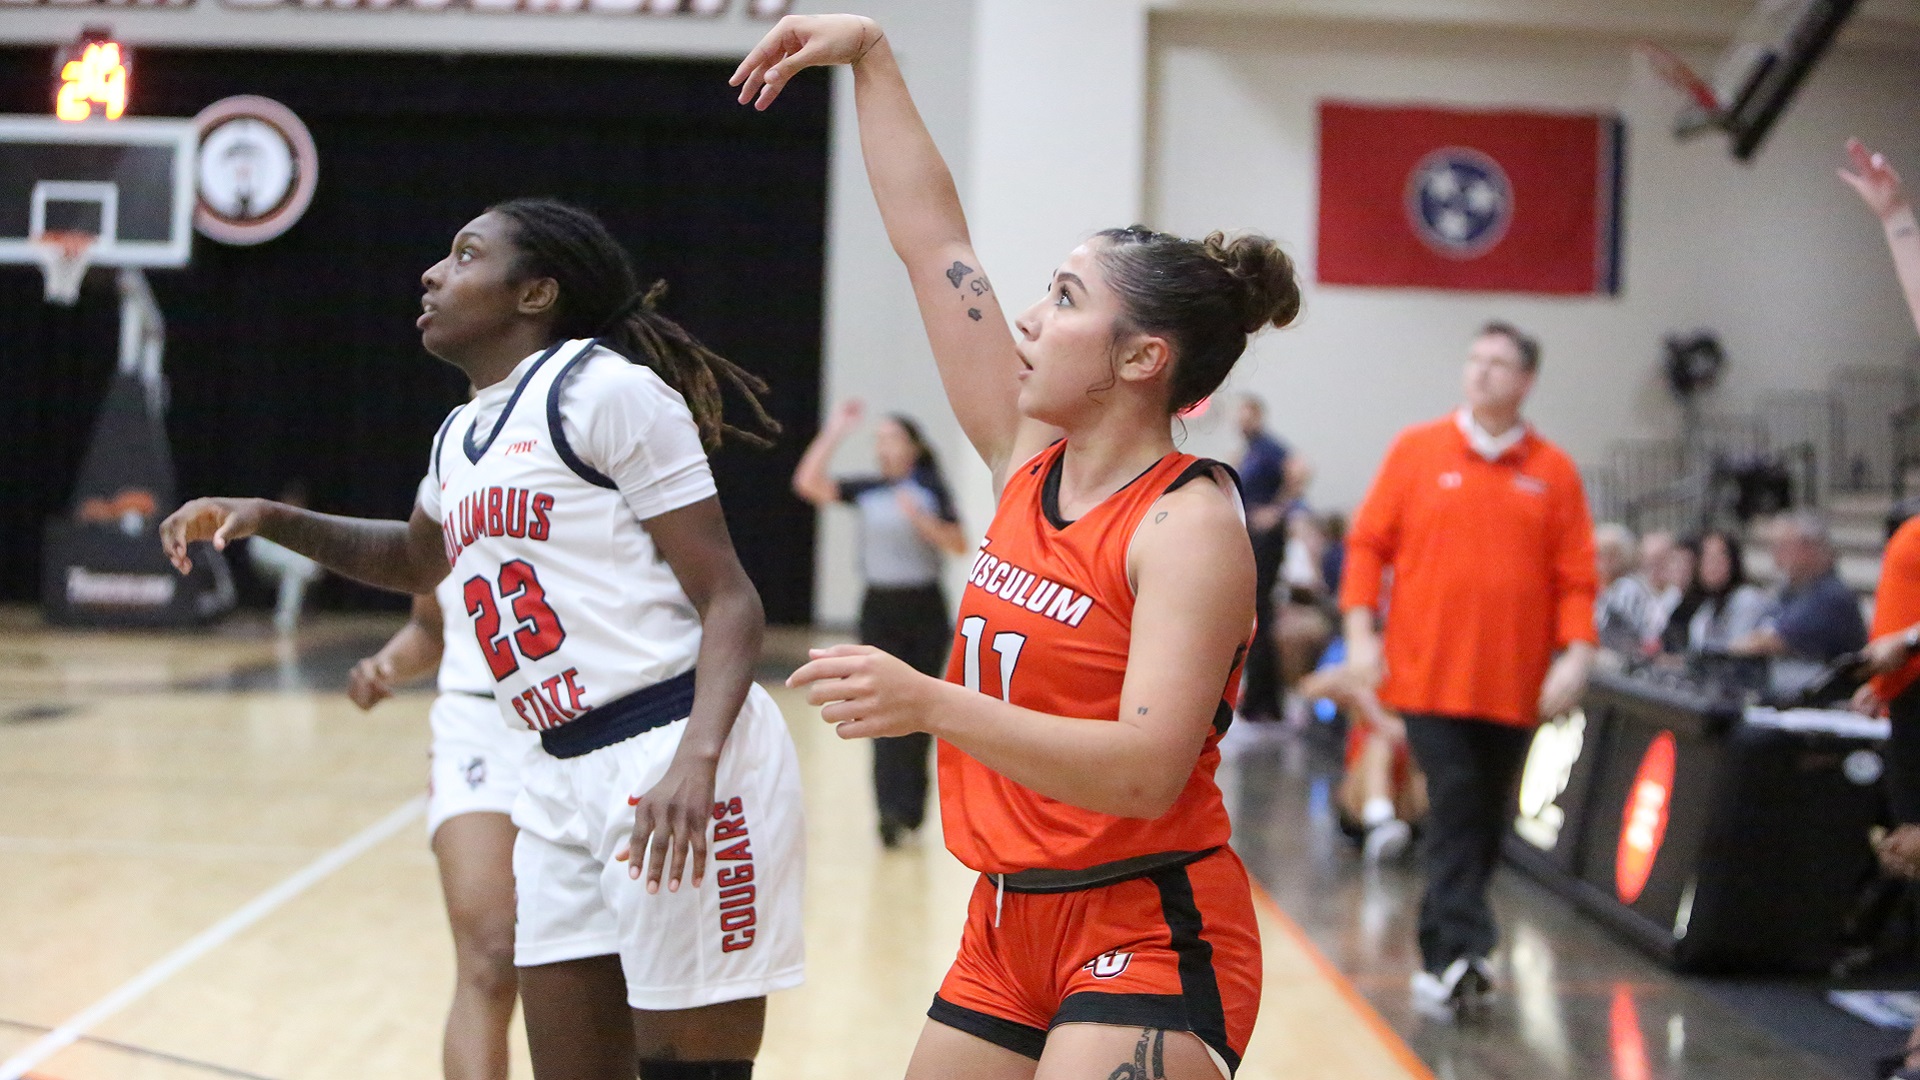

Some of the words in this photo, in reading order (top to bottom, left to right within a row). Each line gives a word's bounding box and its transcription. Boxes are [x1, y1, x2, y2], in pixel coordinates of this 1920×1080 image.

[443, 486, 555, 568] OLUMBUS
[464, 557, 566, 683] 23
[960, 615, 1027, 703] 11
[511, 666, 593, 731] STATE
[712, 796, 756, 953] COUGARS
